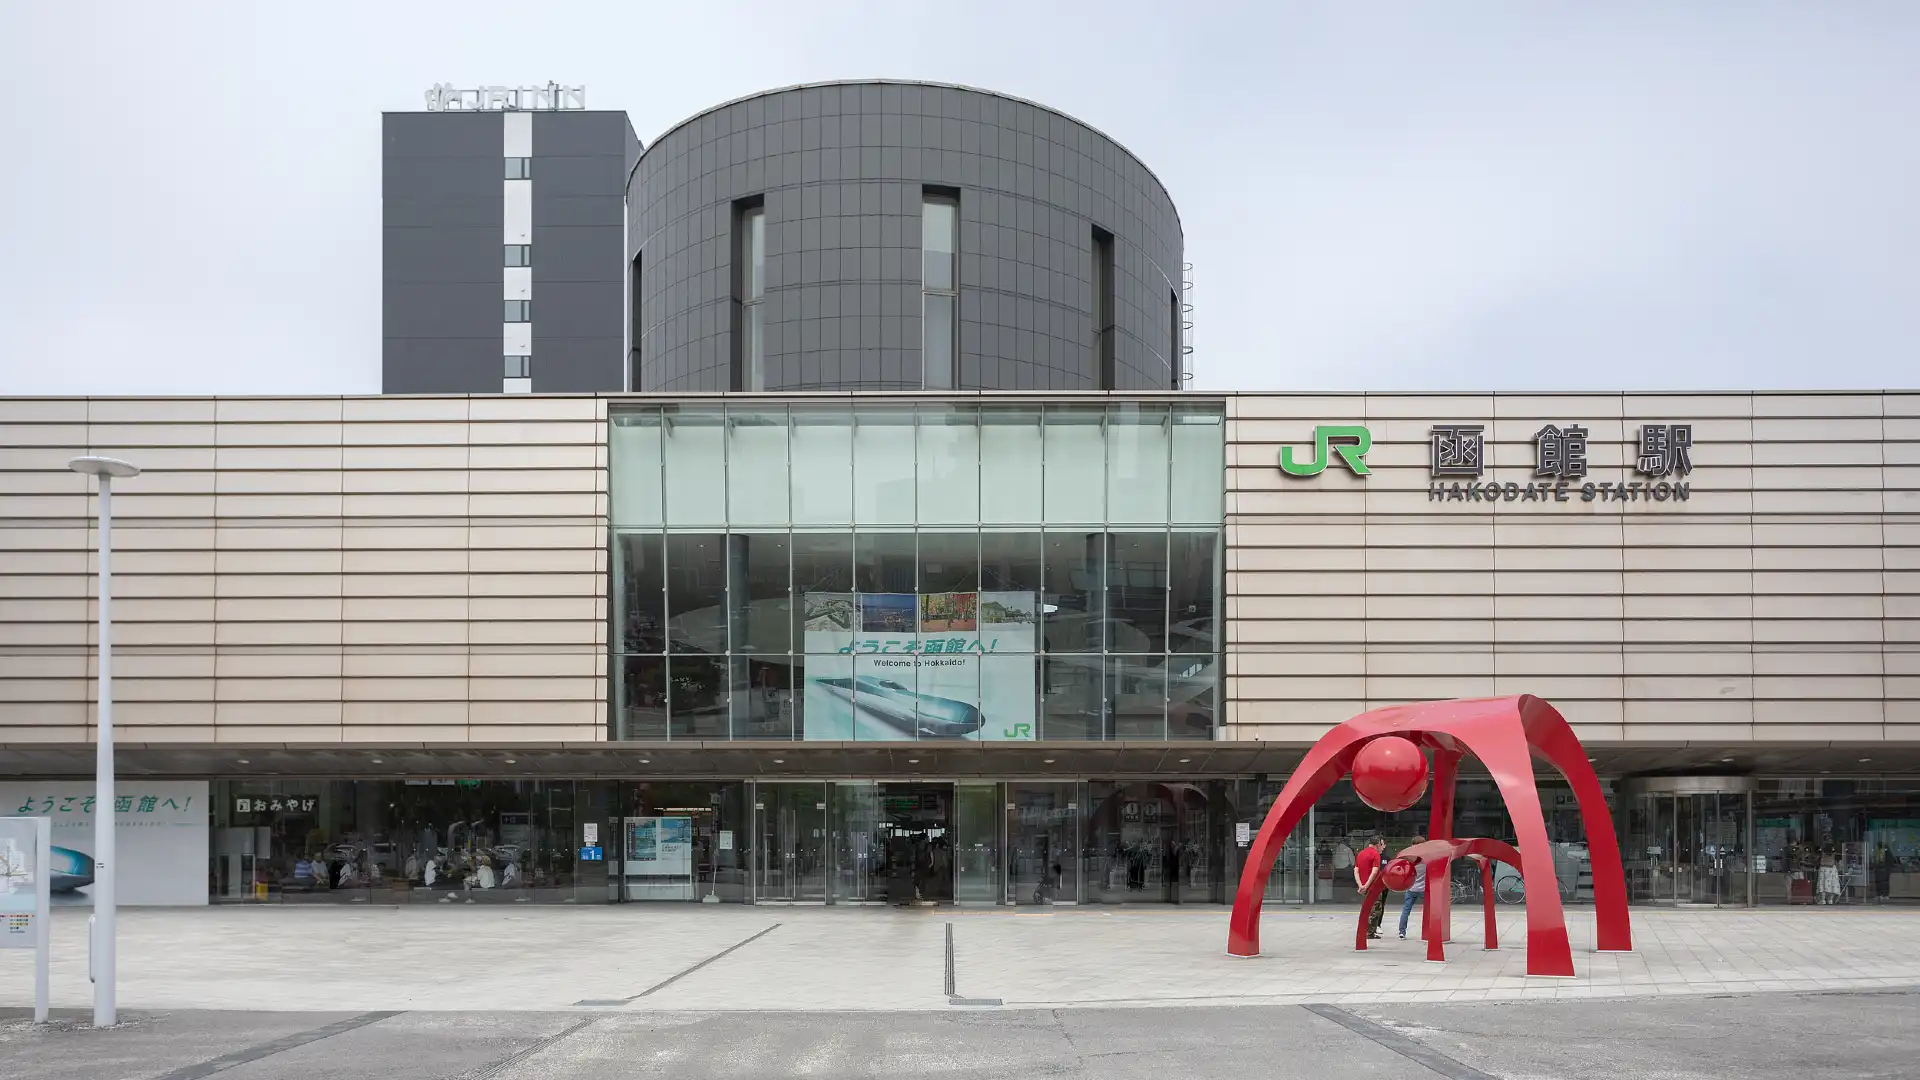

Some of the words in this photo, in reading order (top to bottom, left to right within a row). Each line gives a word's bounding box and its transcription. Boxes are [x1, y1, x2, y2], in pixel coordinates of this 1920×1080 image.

[466, 85, 512, 109] JR
[517, 84, 586, 109] INN
[1279, 424, 1373, 477] JR
[1430, 423, 1694, 477] 函館駅
[1429, 481, 1570, 502] HAKODATE
[1581, 481, 1690, 502] STATION
[873, 659, 911, 667] Welcome
[924, 658, 966, 667] Hokkaido!
[1003, 723, 1031, 738] JR
[253, 798, 316, 812] おみやげ
